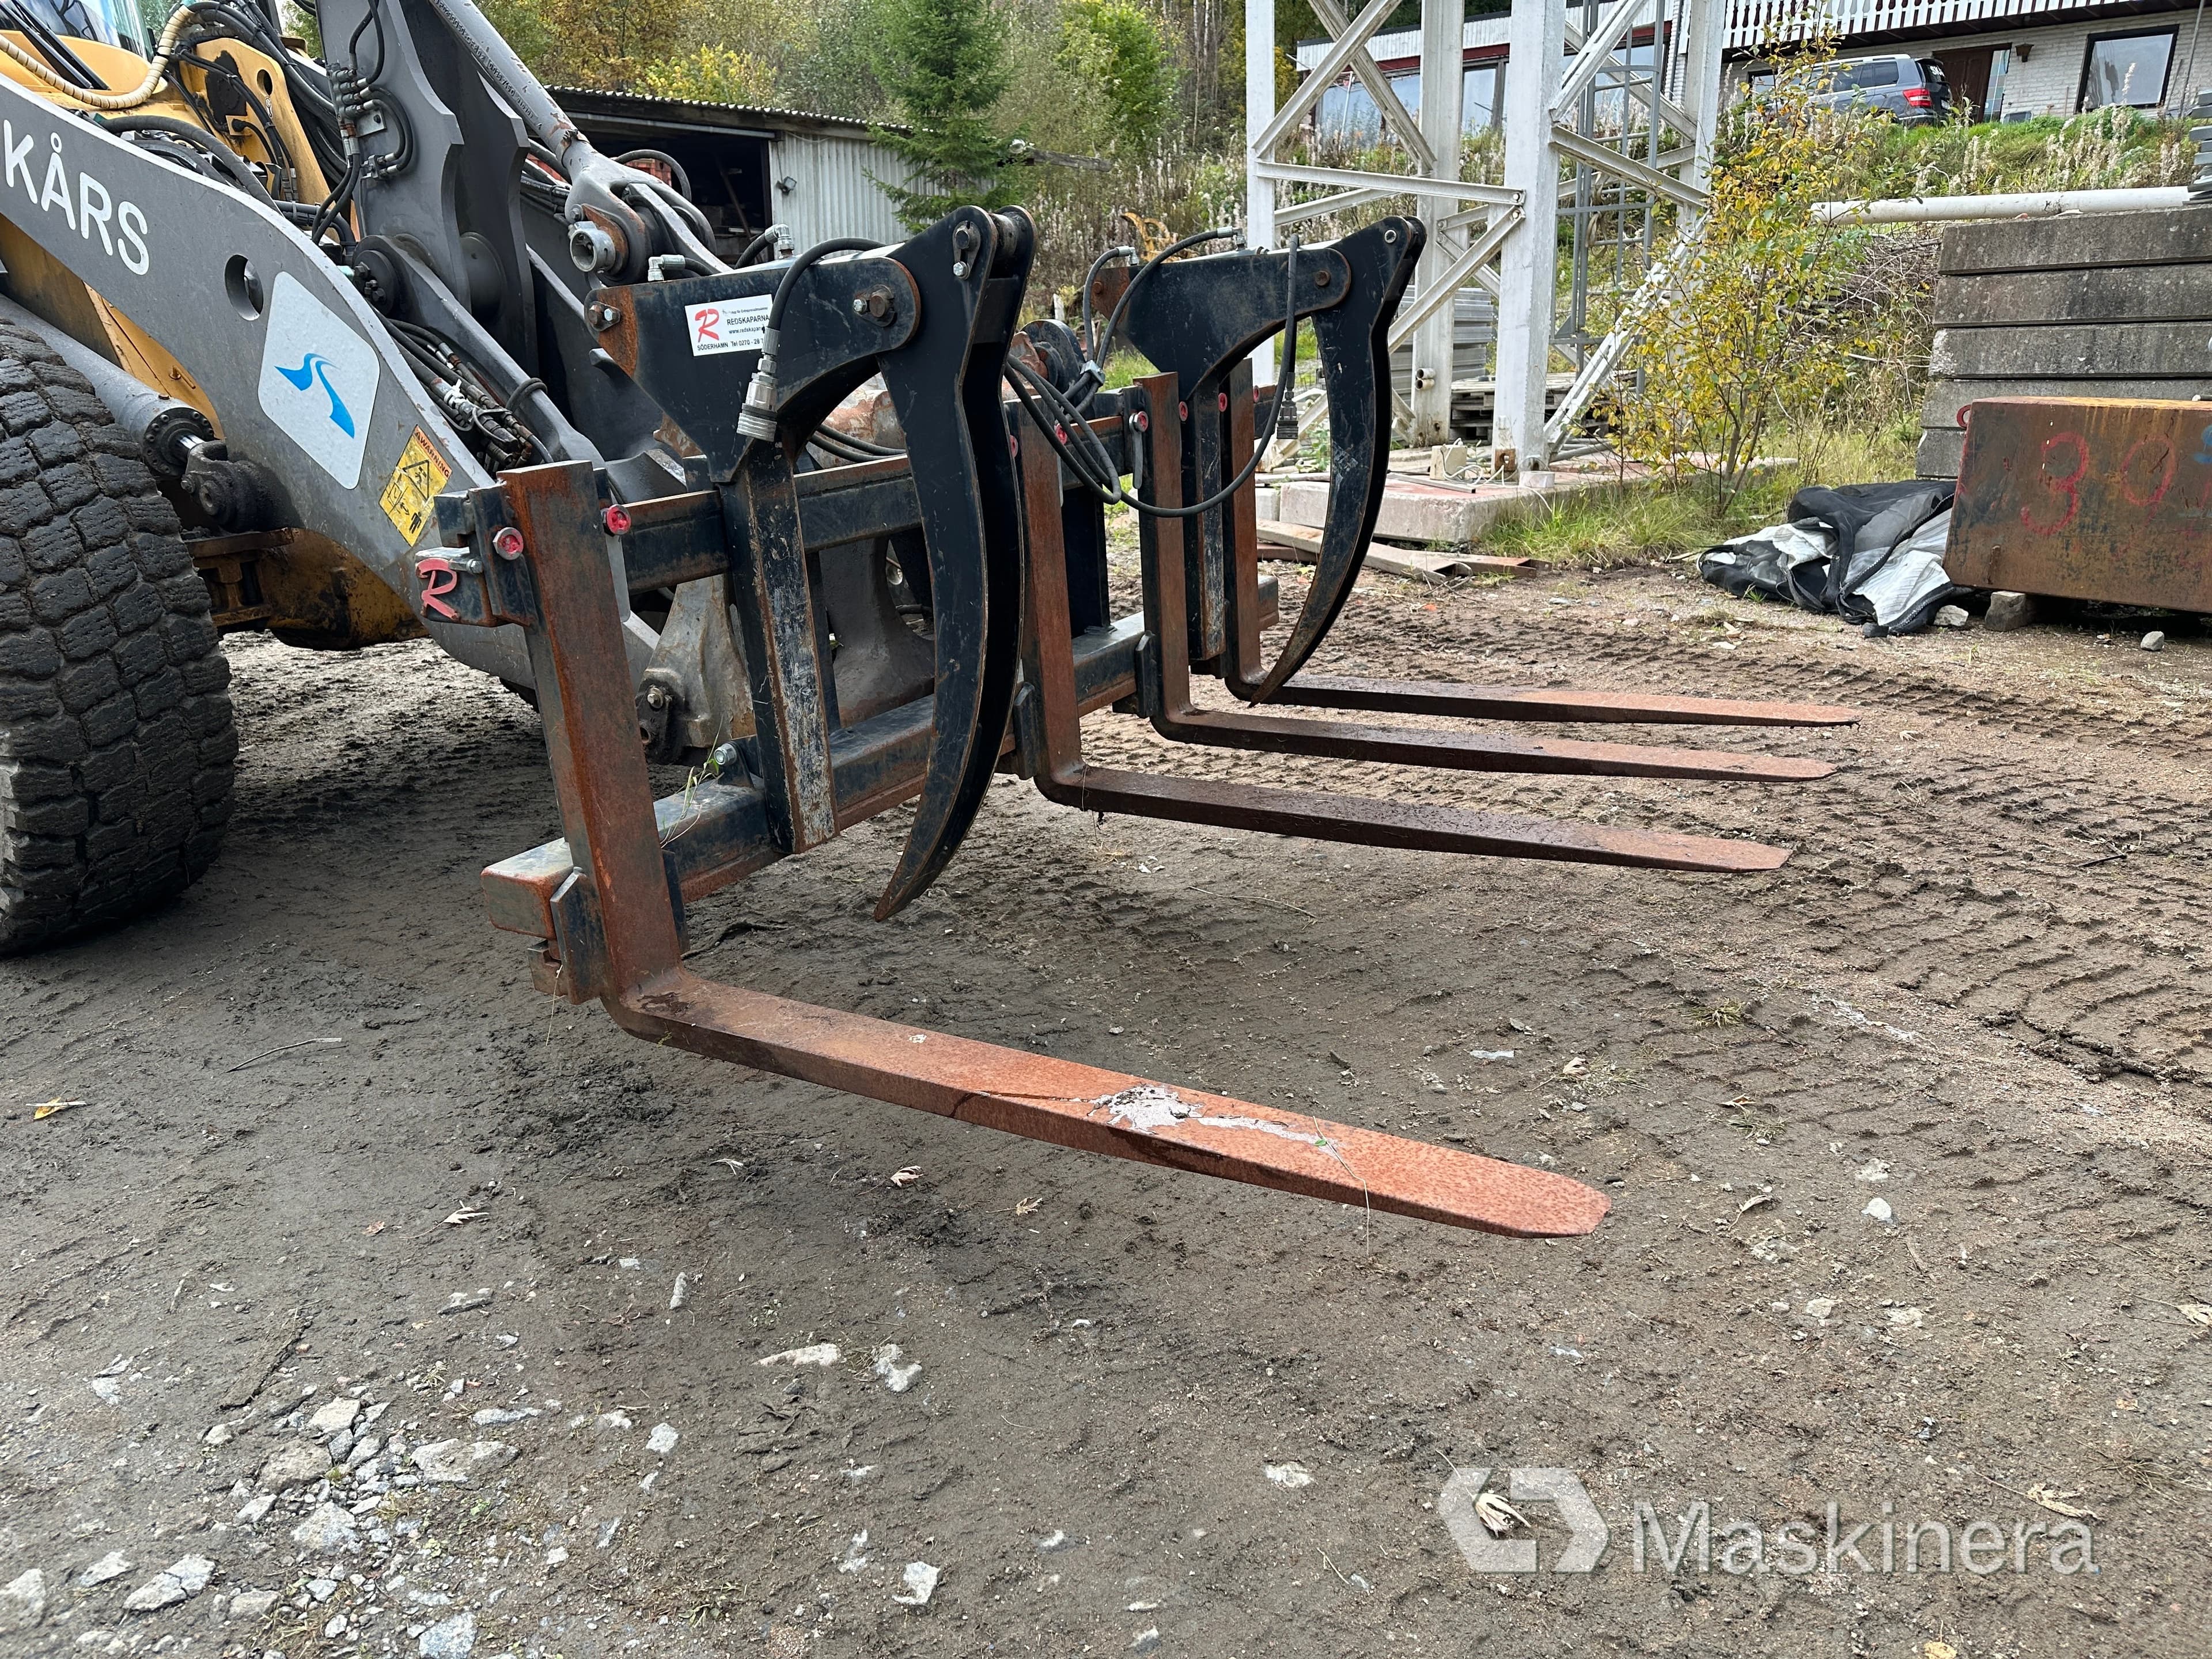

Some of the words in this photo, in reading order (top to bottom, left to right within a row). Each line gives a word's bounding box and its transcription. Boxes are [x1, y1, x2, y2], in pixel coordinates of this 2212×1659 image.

[3, 119, 150, 275] KÅRS
[695, 308, 719, 342] R
[727, 315, 770, 325] REDSKAPARNA
[698, 342, 728, 351] SÖDERHAMN
[420, 437, 450, 478] WARNING
